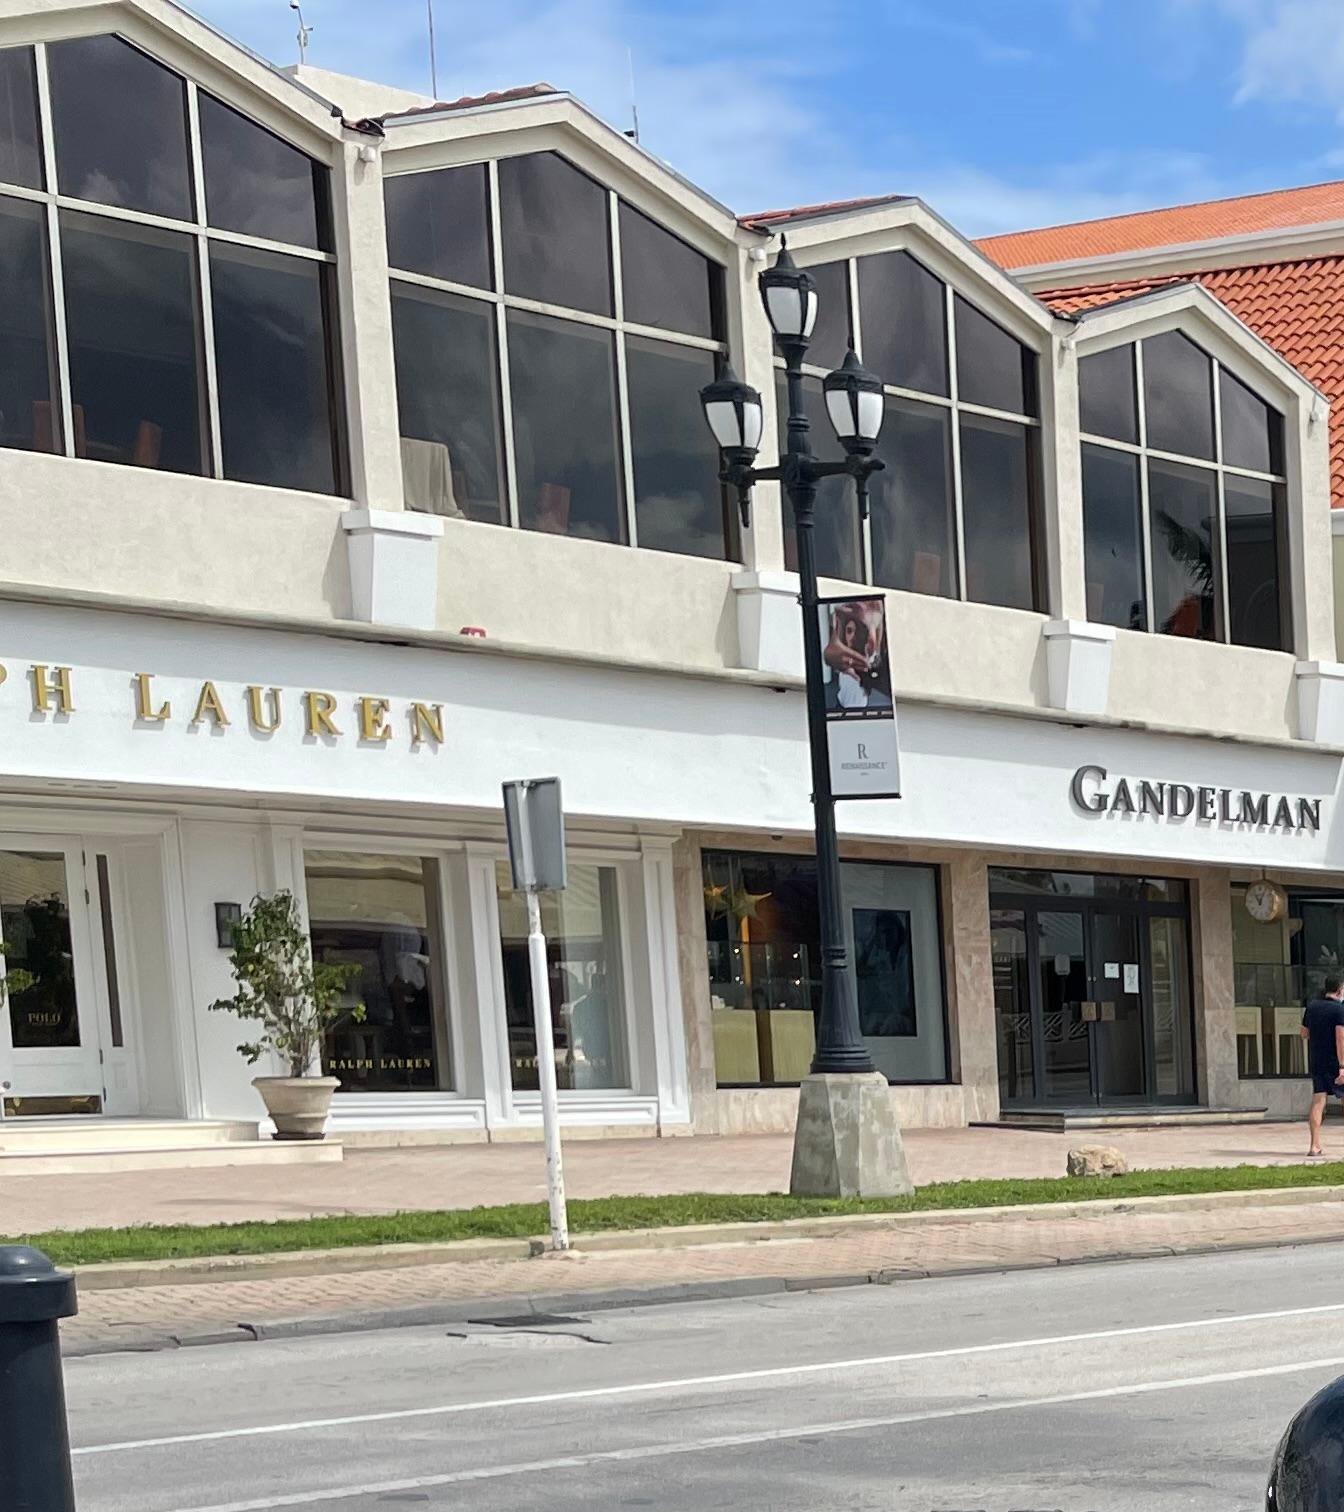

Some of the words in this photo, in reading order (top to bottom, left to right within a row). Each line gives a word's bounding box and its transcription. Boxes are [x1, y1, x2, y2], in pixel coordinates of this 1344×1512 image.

[0, 663, 76, 714] H
[134, 672, 446, 744] LAUREN
[1072, 764, 1322, 830] GANDELMAN
[329, 1058, 374, 1070] RALPH
[380, 1058, 432, 1070] LAUREN
